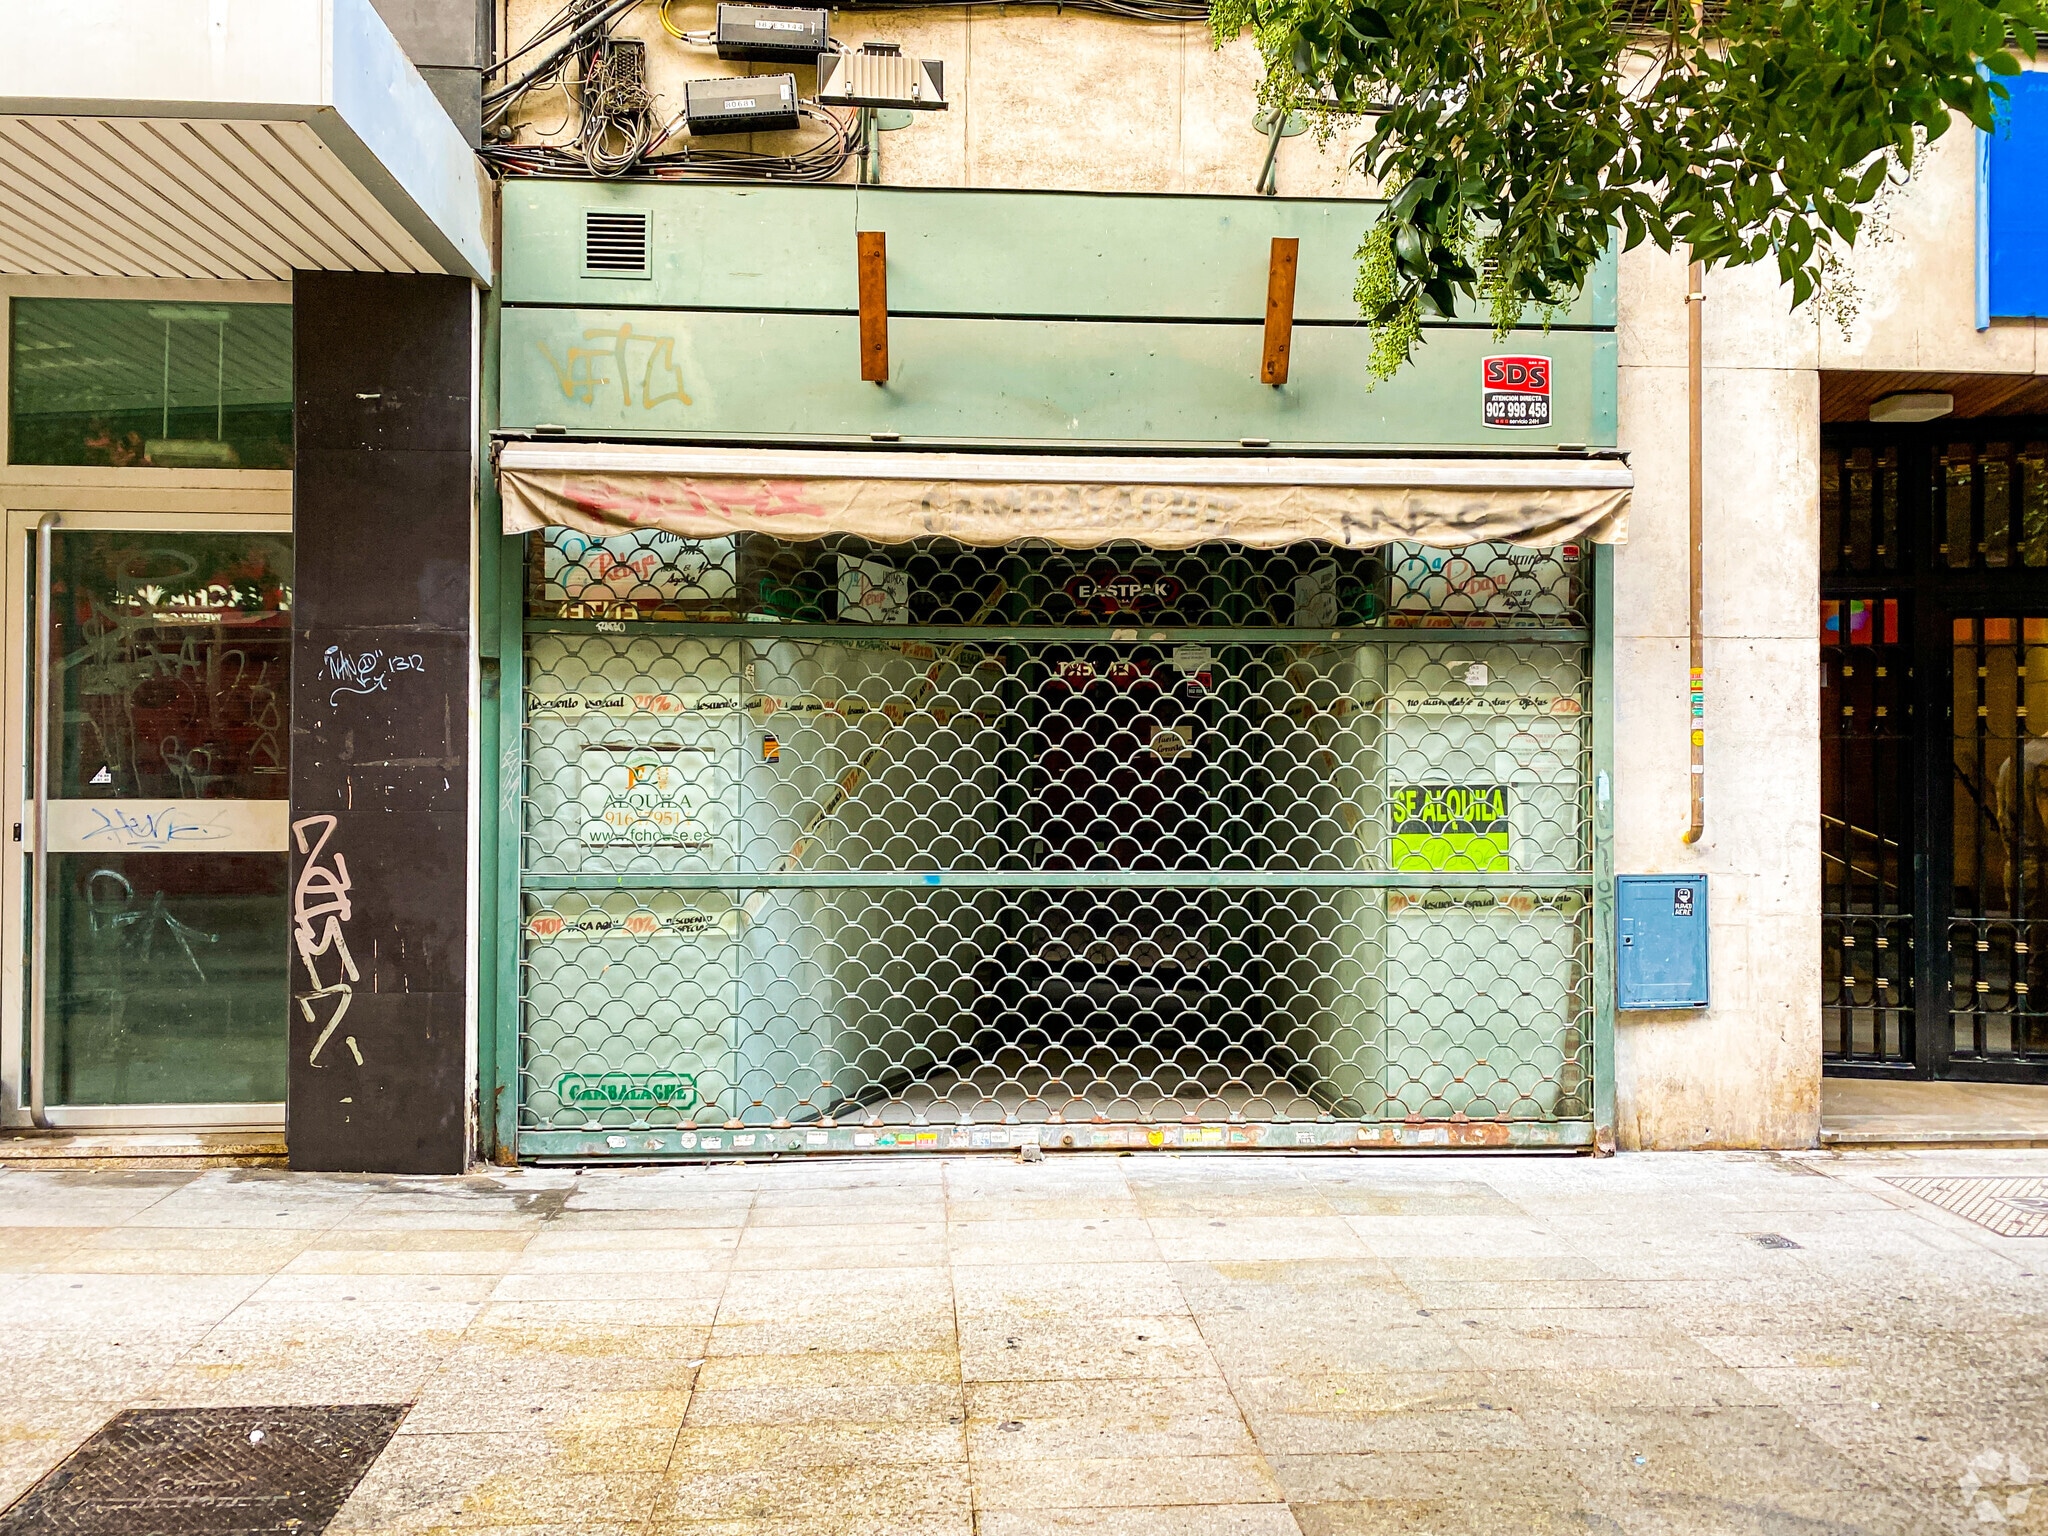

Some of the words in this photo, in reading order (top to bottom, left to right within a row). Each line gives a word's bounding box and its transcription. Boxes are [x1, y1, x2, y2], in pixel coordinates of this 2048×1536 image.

[1488, 360, 1546, 388] SDS
[1486, 402, 1506, 418] 902
[1508, 402, 1527, 418] 998
[1528, 402, 1548, 418] 458
[1079, 583, 1168, 598] EASTPAK
[1407, 698, 1419, 707] no
[1477, 698, 1484, 708] a
[1393, 790, 1417, 823] SE
[1422, 788, 1505, 830] ALQUILA
